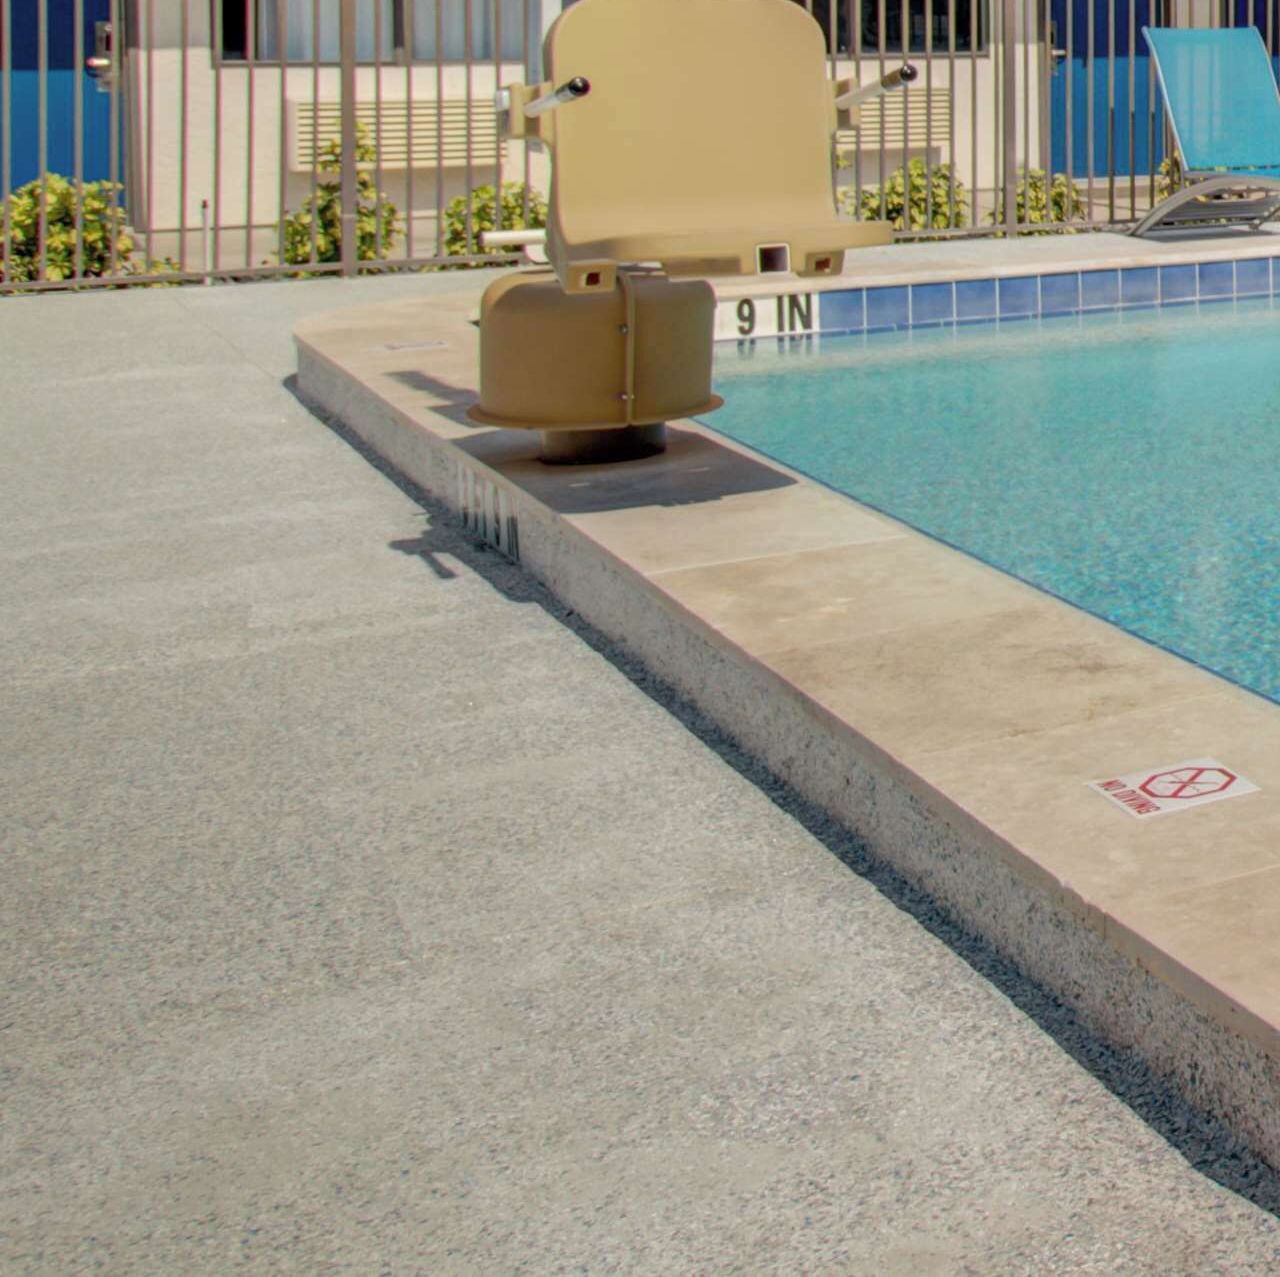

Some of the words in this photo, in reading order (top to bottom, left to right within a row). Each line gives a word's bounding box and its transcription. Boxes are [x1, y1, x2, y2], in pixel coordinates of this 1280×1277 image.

[737, 298, 755, 335] 9
[777, 292, 812, 332] IN
[1097, 779, 1126, 791] NO
[1112, 789, 1160, 814] DIVING
